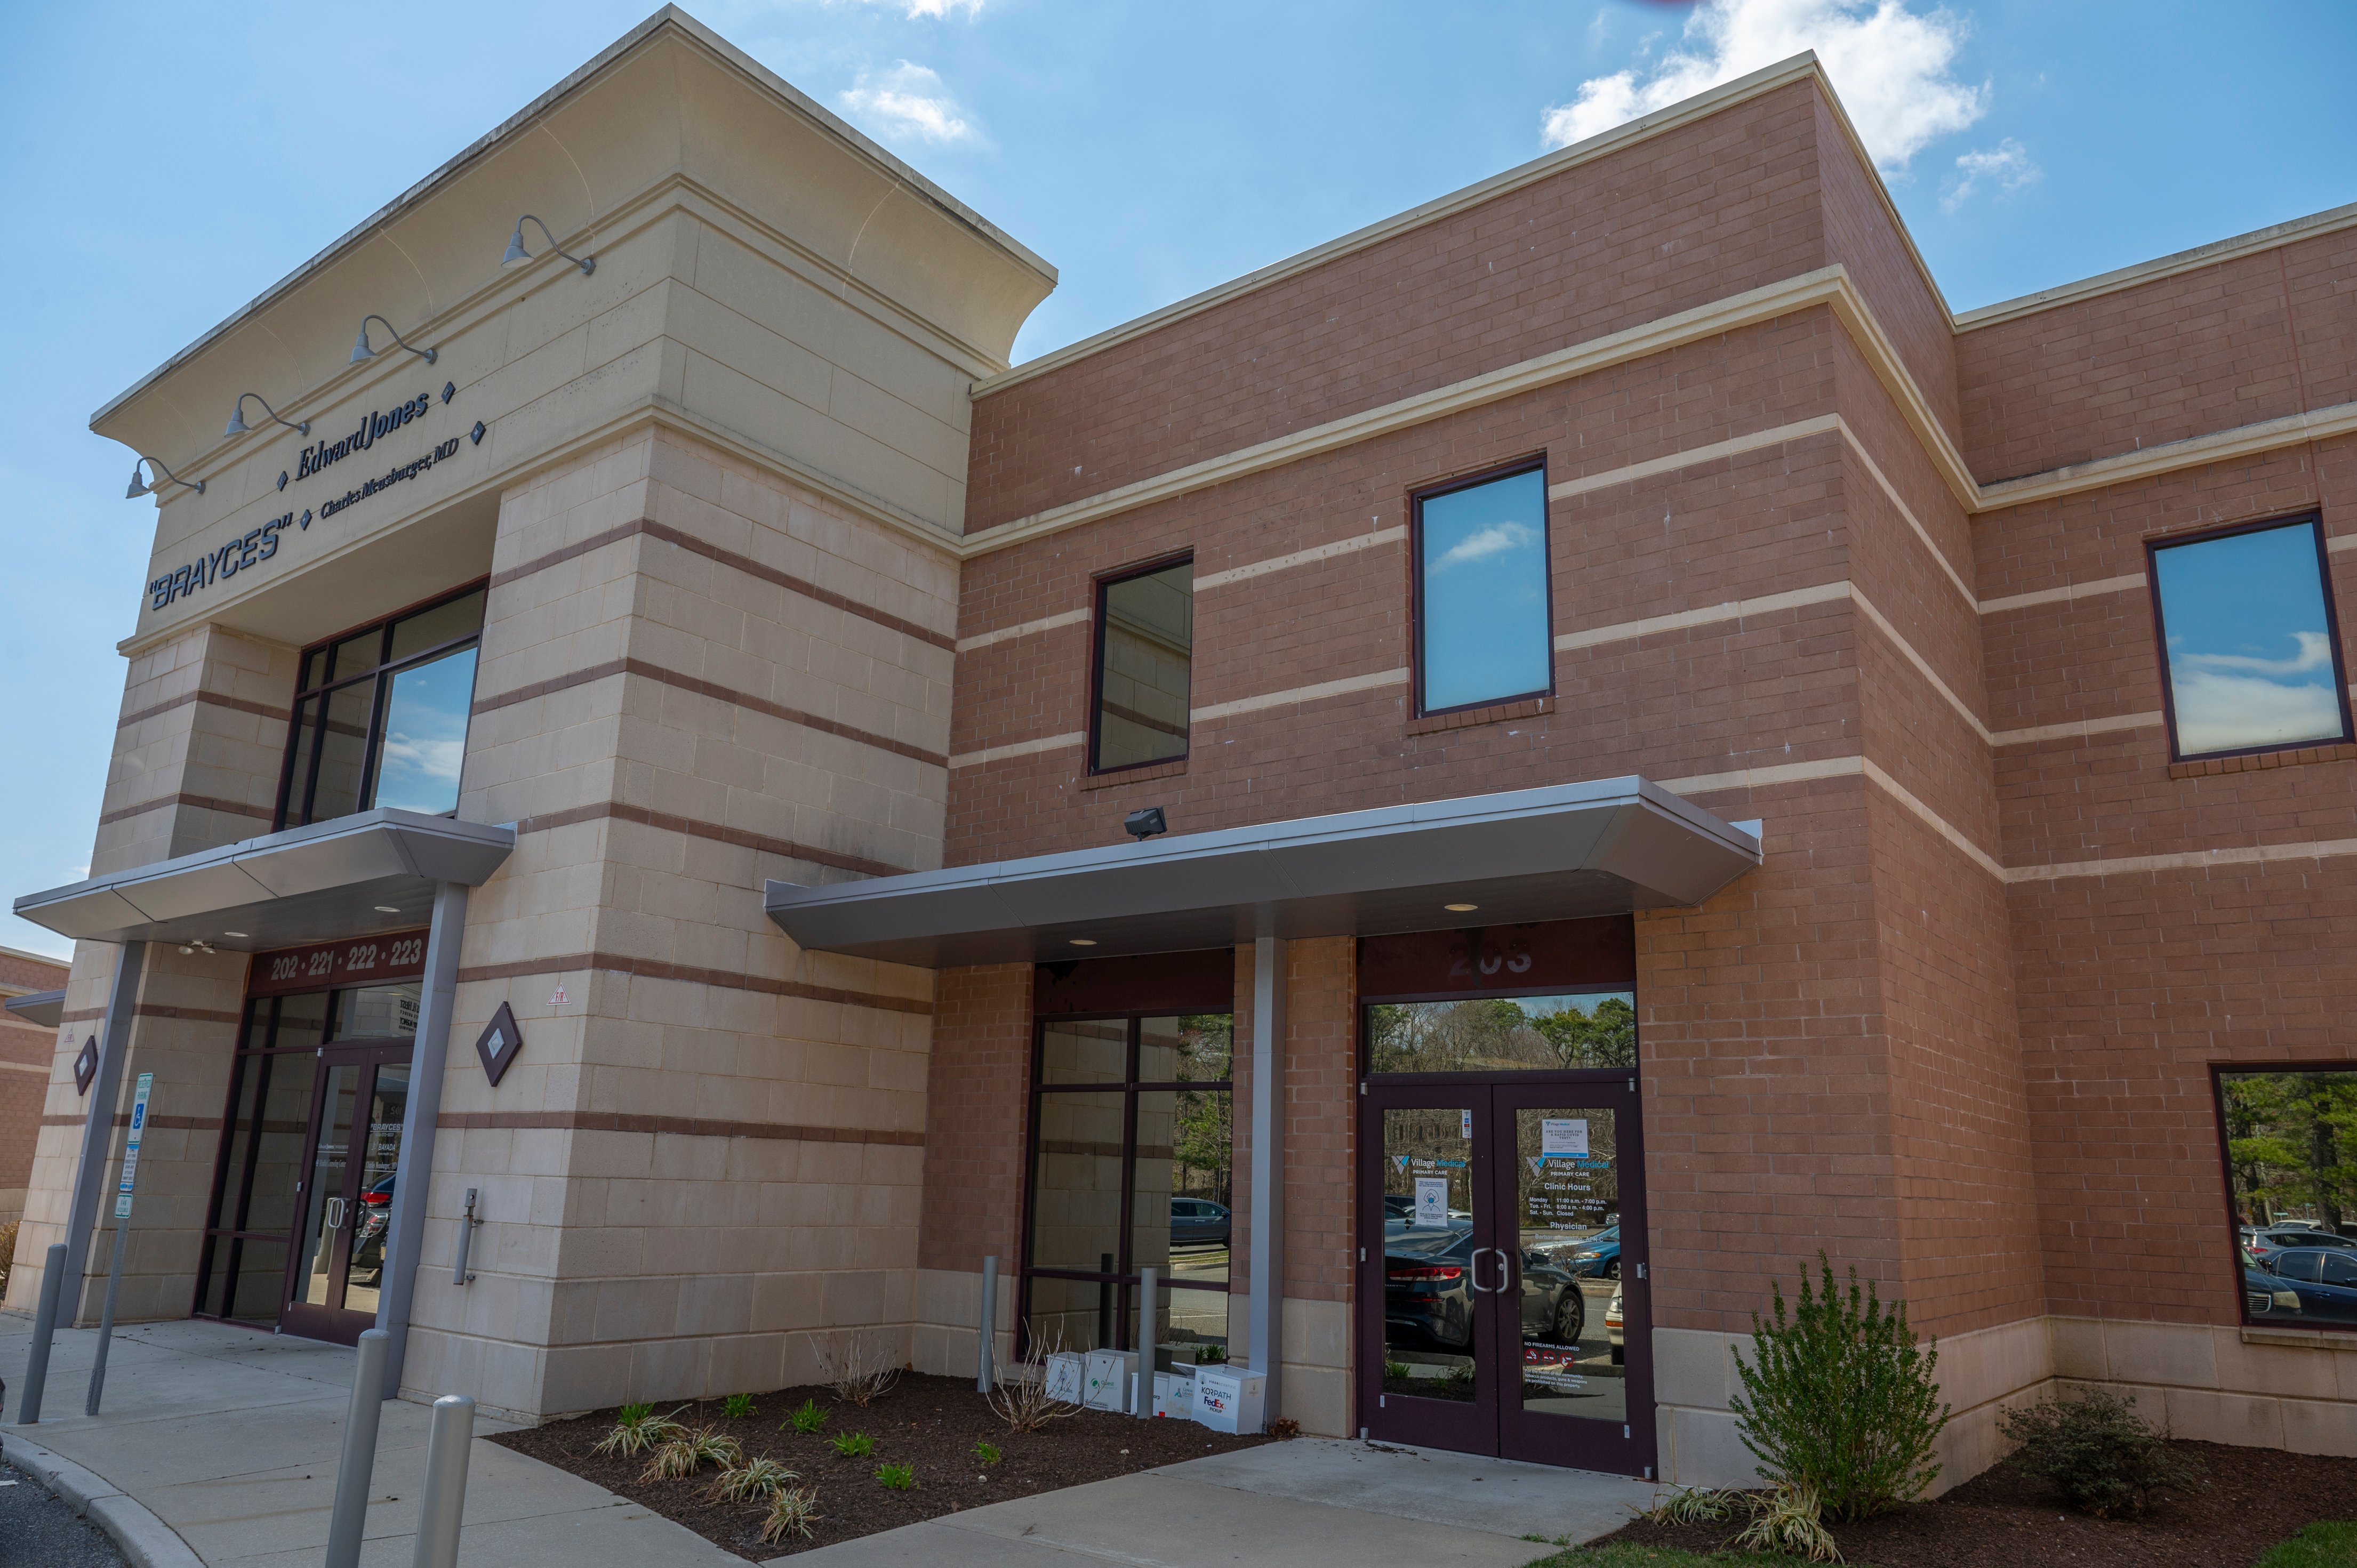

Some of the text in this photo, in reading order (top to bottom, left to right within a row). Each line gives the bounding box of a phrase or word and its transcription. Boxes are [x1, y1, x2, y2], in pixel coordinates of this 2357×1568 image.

[320, 438, 460, 519] Charles Meusburger, MD
[270, 937, 422, 981] 202 221 222 223
[1449, 938, 1532, 978] 203
[555, 991, 564, 1002] F/R
[1411, 1159, 1434, 1169] Village
[1549, 1159, 1575, 1170] Village
[1550, 1221, 1587, 1231] Physician
[1204, 1396, 1224, 1410] FedEx
